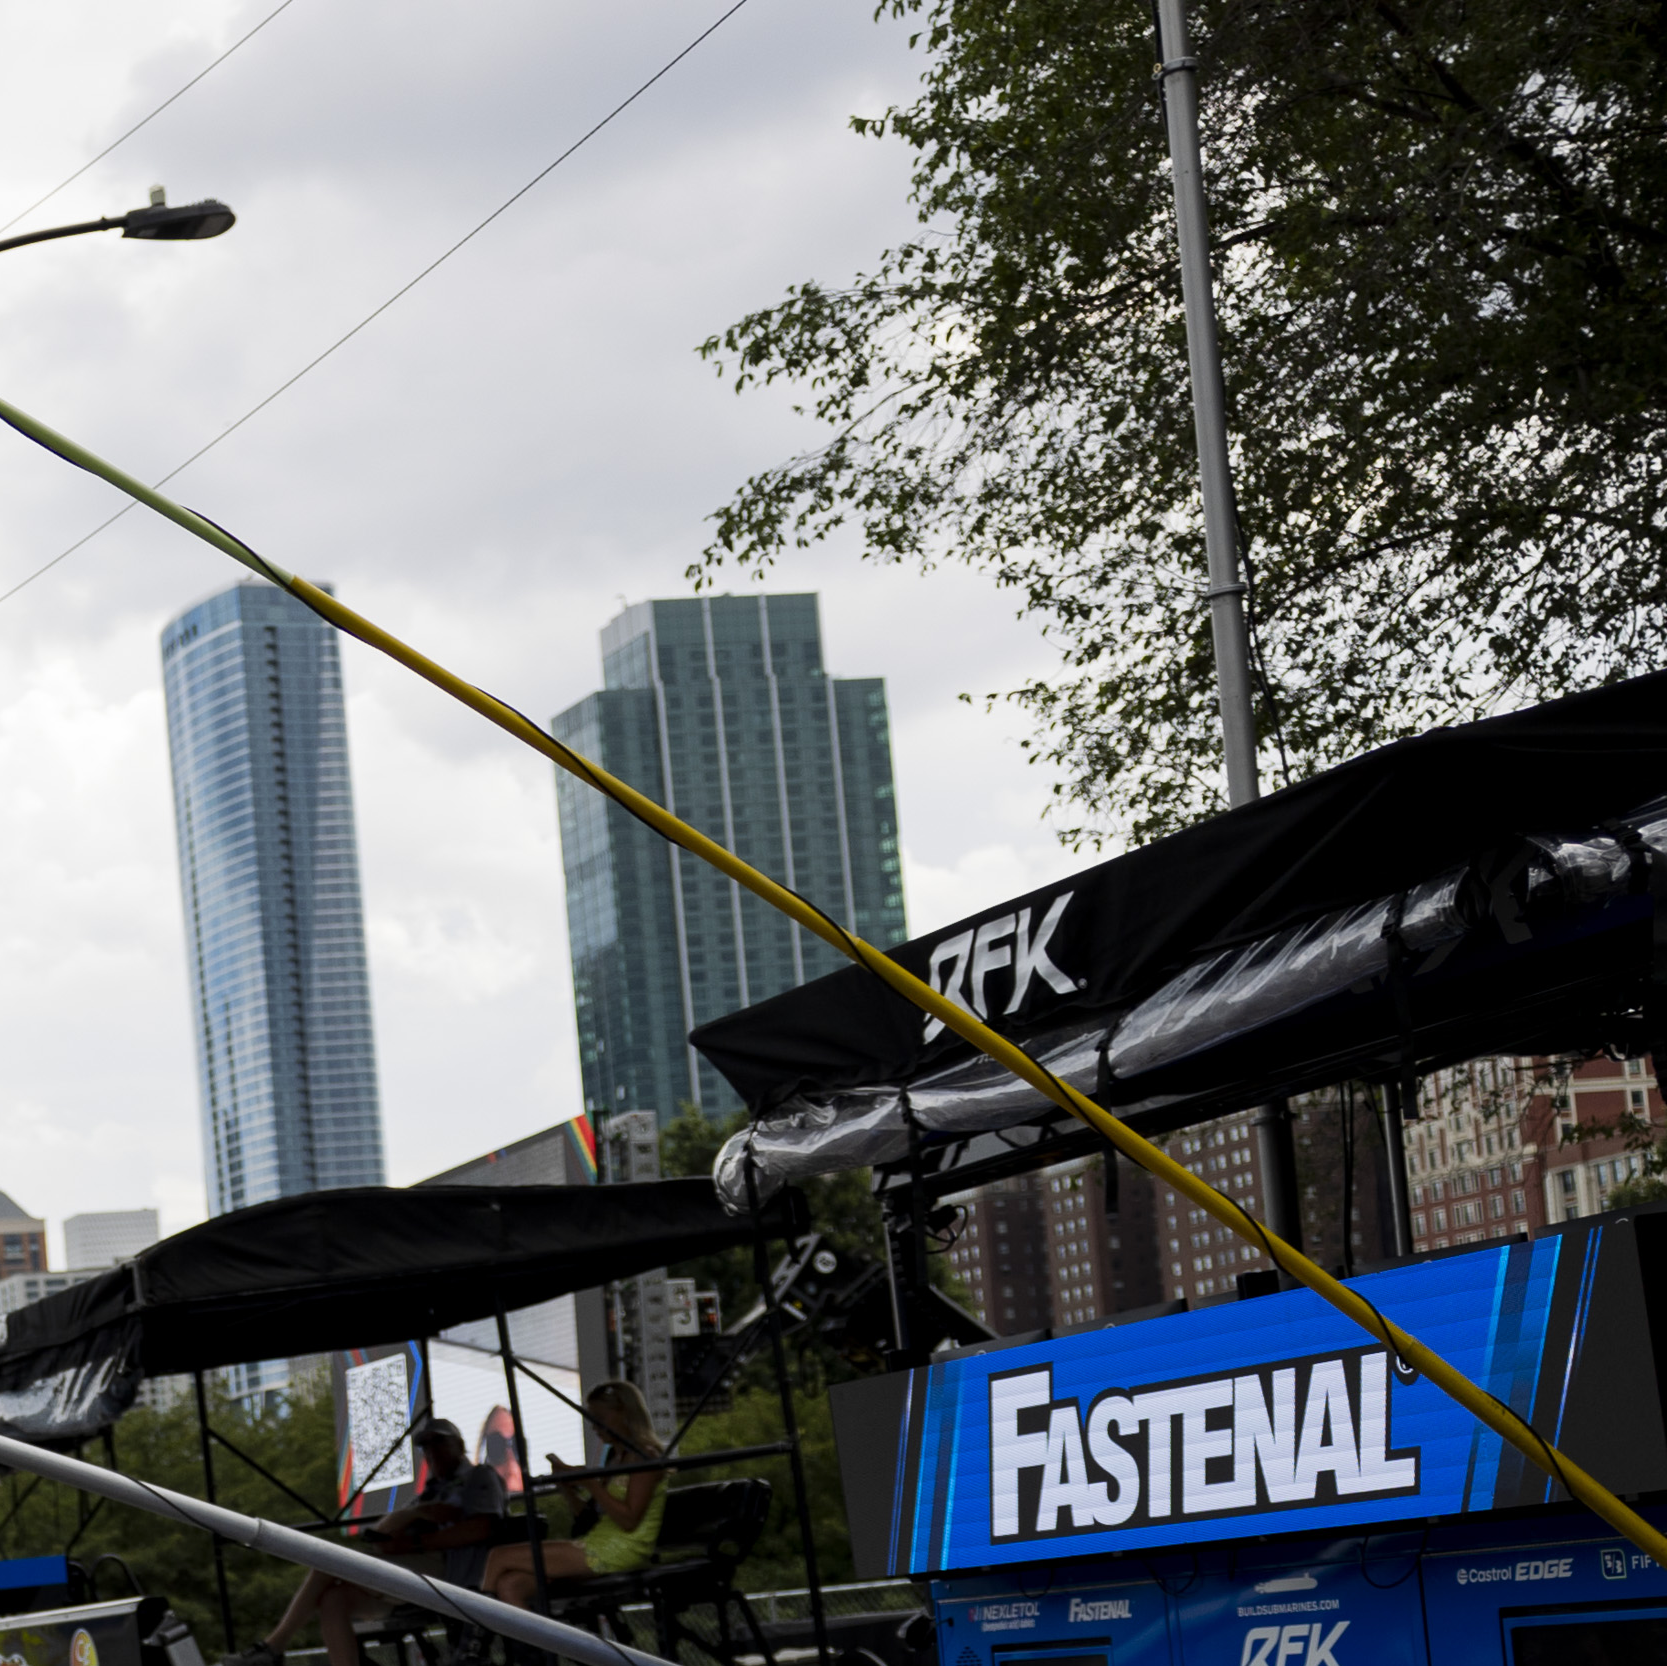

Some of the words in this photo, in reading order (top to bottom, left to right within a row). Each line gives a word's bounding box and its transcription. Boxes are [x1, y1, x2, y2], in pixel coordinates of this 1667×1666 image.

[922, 889, 1079, 1045] RFK
[989, 1351, 1417, 1538] FASTENAL
[1468, 1566, 1513, 1583] Castrol
[1514, 1557, 1574, 1581] EDGE
[1631, 1553, 1661, 1569] FIF
[1067, 1597, 1133, 1623] FASTENAL
[1236, 1599, 1340, 1617] BUILDSUBMARINES.COM
